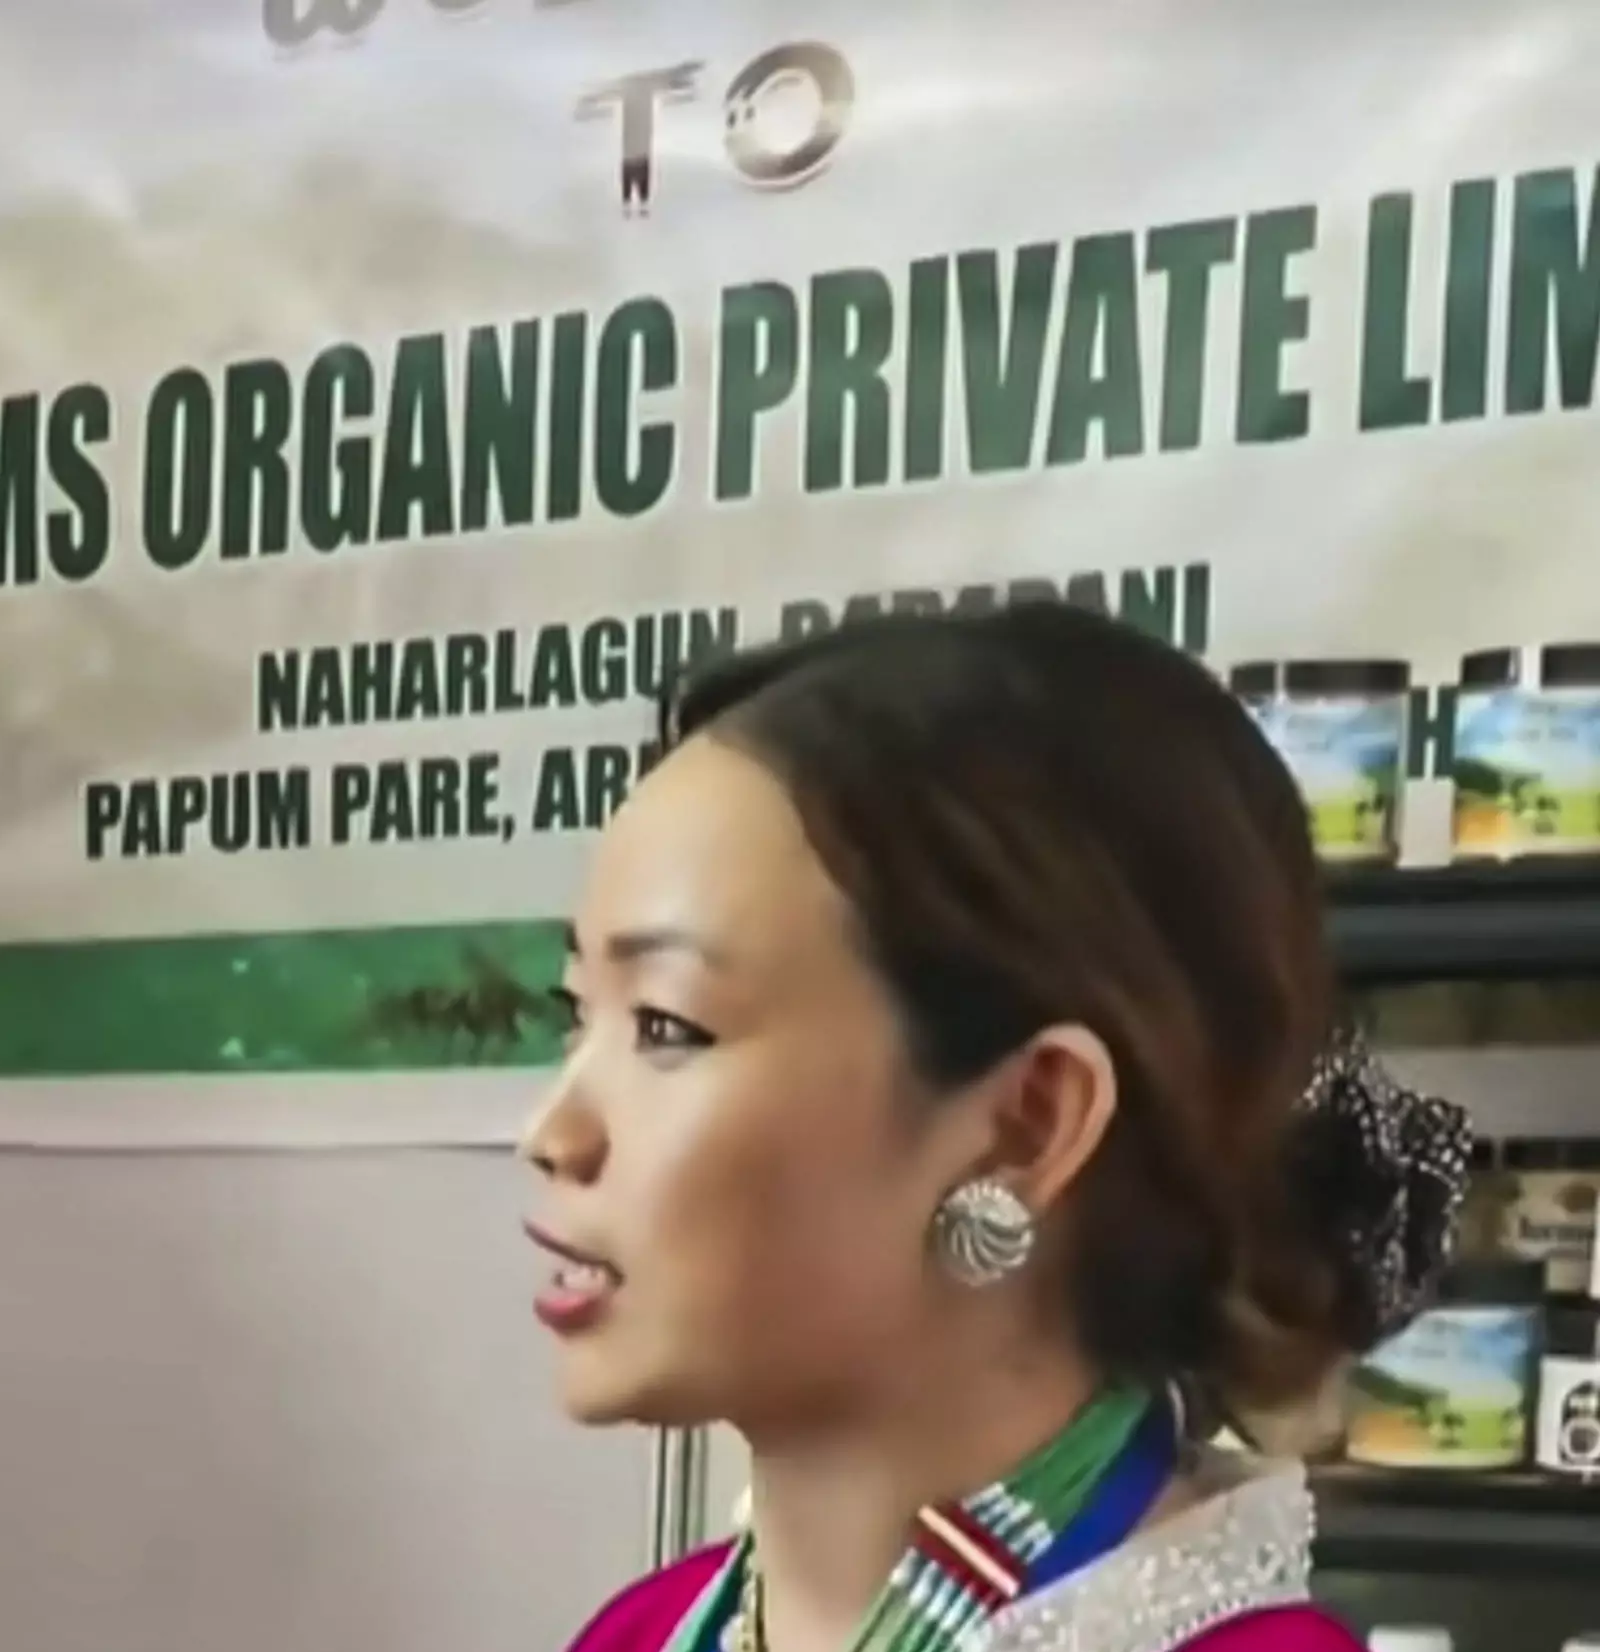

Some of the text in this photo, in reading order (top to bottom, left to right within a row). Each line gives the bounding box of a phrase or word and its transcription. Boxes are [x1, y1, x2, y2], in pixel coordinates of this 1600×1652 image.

[574, 41, 855, 217] TO
[141, 295, 678, 571] ORGANIC
[714, 204, 1319, 503] PRIVATE
[85, 766, 311, 860] PAPUM
[331, 751, 516, 843] PARE,
